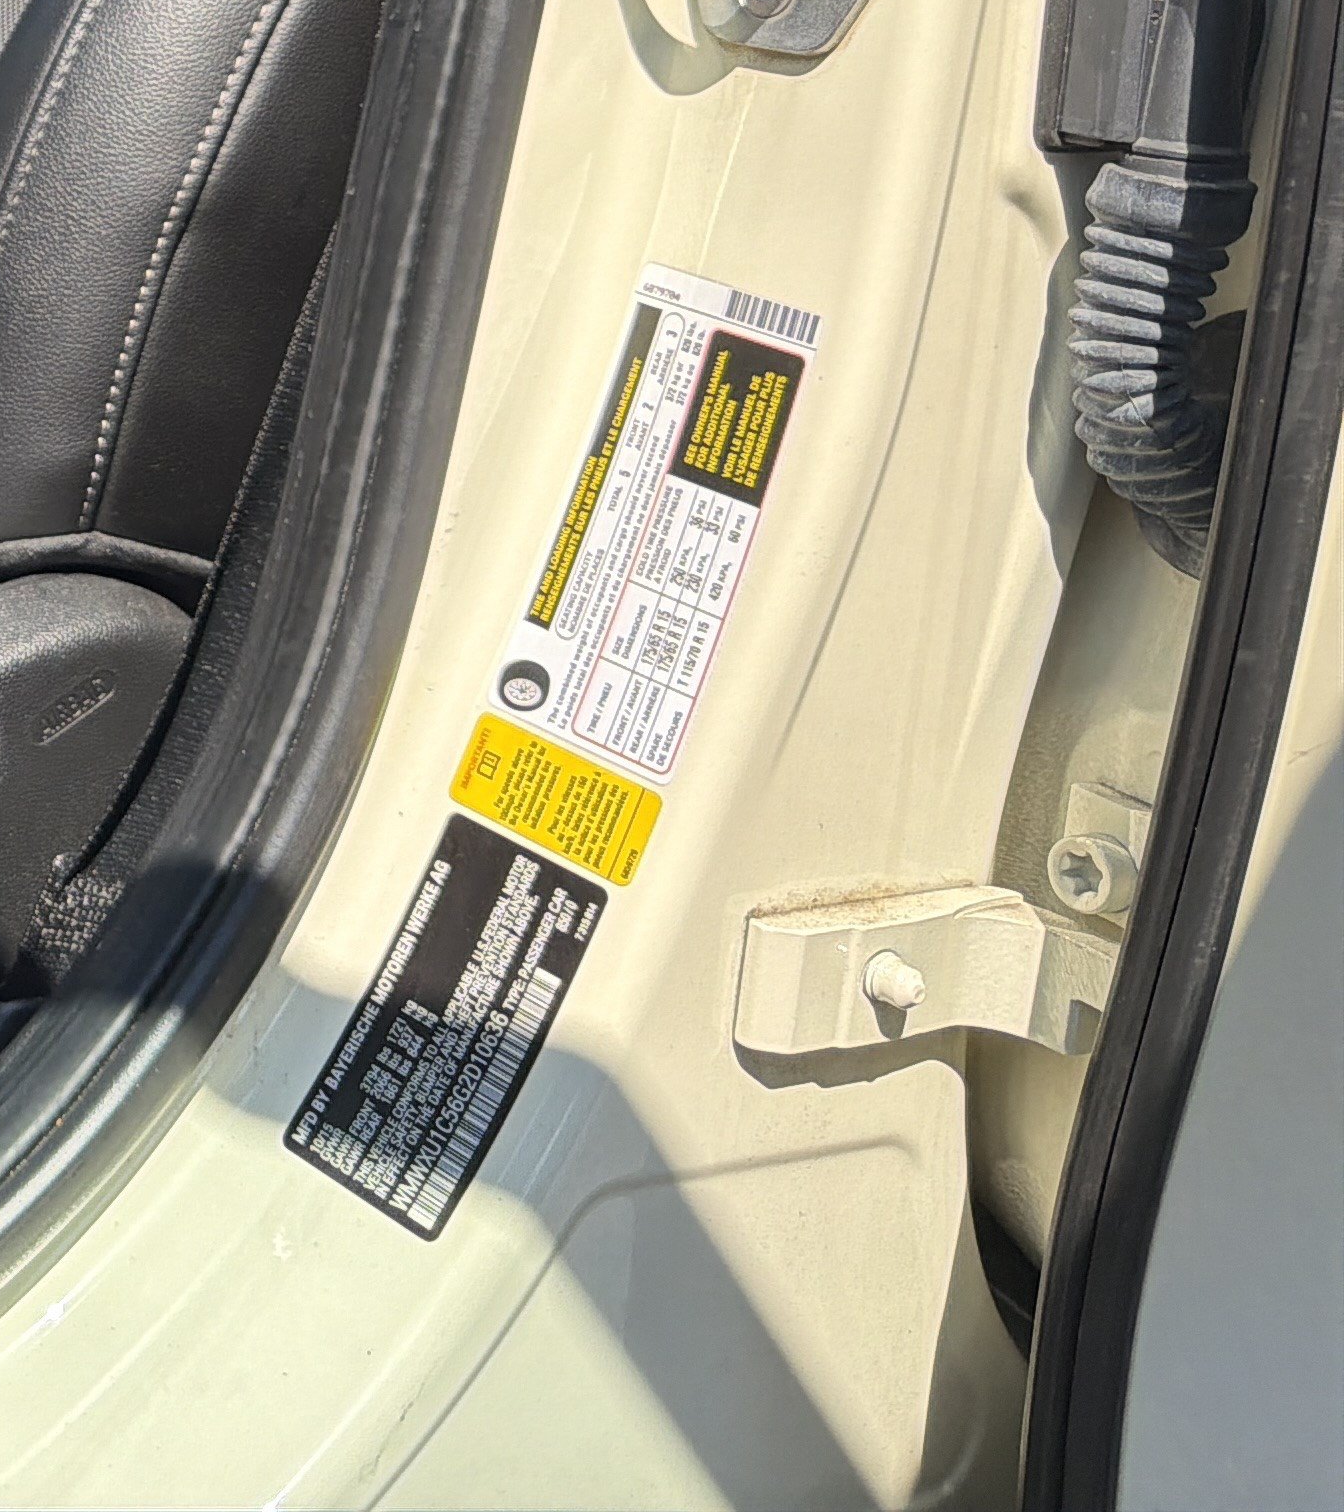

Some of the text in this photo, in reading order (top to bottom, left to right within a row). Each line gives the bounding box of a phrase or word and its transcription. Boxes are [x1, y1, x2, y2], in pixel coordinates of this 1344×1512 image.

[649, 350, 663, 375] REAR
[665, 328, 678, 338] 3
[610, 356, 643, 427] CHARGEMENT
[633, 401, 654, 450] AVANT 2
[683, 348, 730, 465] SEE OWNER'S MANUAL
[693, 380, 731, 469] FOR ADDITIONAL
[600, 440, 614, 456] ET
[606, 426, 619, 442] LE
[625, 417, 641, 447] FRONT
[704, 398, 738, 473] INFORMATION
[720, 374, 762, 479] VOIR LE MANUEL DE
[731, 370, 776, 483] L'USAGER POUR PLUS
[743, 374, 789, 487] DE RENSEIGNEMENTS
[581, 489, 596, 510] LES
[588, 455, 609, 490] PNEUS
[606, 484, 623, 512] TOTAL
[529, 454, 597, 617] TIRE AND LOADING INFORMATION
[573, 509, 589, 532] SUR
[635, 484, 673, 577] COLD TIRE PRESSURE
[644, 486, 683, 580] PRESSION DES PNEUS
[546, 435, 660, 725] The combined weight of occupants and cargo should never exceed
[558, 550, 593, 630] SEATING CAPACITY
[655, 547, 672, 576] FROID
[707, 581, 723, 602] 420
[727, 529, 741, 543] 60
[611, 635, 624, 656] SIZE
[620, 602, 647, 660] DIMENSIONS
[640, 608, 672, 666] 175/65 R 15
[656, 614, 688, 673] 175/65 R 15
[676, 619, 710, 687] T 115/70 R 15
[586, 681, 612, 734] TIRE PNEU
[611, 678, 643, 746] FRONT AVANT
[629, 728, 644, 754] REAR
[656, 709, 683, 767] DE SECOURS
[646, 731, 663, 762] SPARE
[501, 886, 568, 1012] TYPE: PASSENGER CAR
[291, 858, 452, 1145] MFD BY BAYERISCHE MOTOREN WERKE AG
[353, 1157, 373, 1185] THIS
[367, 1115, 398, 1162] VEHICLE
[392, 1058, 429, 1119] CONFORMS
[423, 1044, 437, 1060] TO
[430, 1023, 448, 1045] ALL
[440, 961, 479, 1025] APPLICABLE
[500, 854, 529, 895] MOTOR
[363, 1143, 396, 1193] VEHICLE
[391, 1101, 421, 1148] SAFETY,
[415, 1055, 445, 1104] BUMPER
[439, 1031, 458, 1057] AND
[451, 995, 476, 1032] THEFT
[467, 926, 510, 997] PREVENTION
[499, 860, 541, 927] STANDARDS
[319, 998, 417, 1162] GVWR 3794 lbs 1721 kg
[329, 1004, 428, 1169] GAWR FRONT 2066 lbs 937 kg
[340, 1011, 439, 1176] GAWR REAR 1861 lbs 844 kg
[374, 1182, 390, 1200] IN
[383, 1143, 412, 1186] EFFECT
[405, 1126, 421, 1145] ON
[416, 1102, 435, 1127] THE
[427, 1073, 450, 1105] DATE
[443, 1057, 459, 1075] OF
[451, 975, 501, 1059] MANUFACTURE
[491, 932, 522, 978] SHOWN
[309, 1121, 333, 1155] 10/15
[389, 1006, 509, 1217] WMWXU1C56G2D10636
